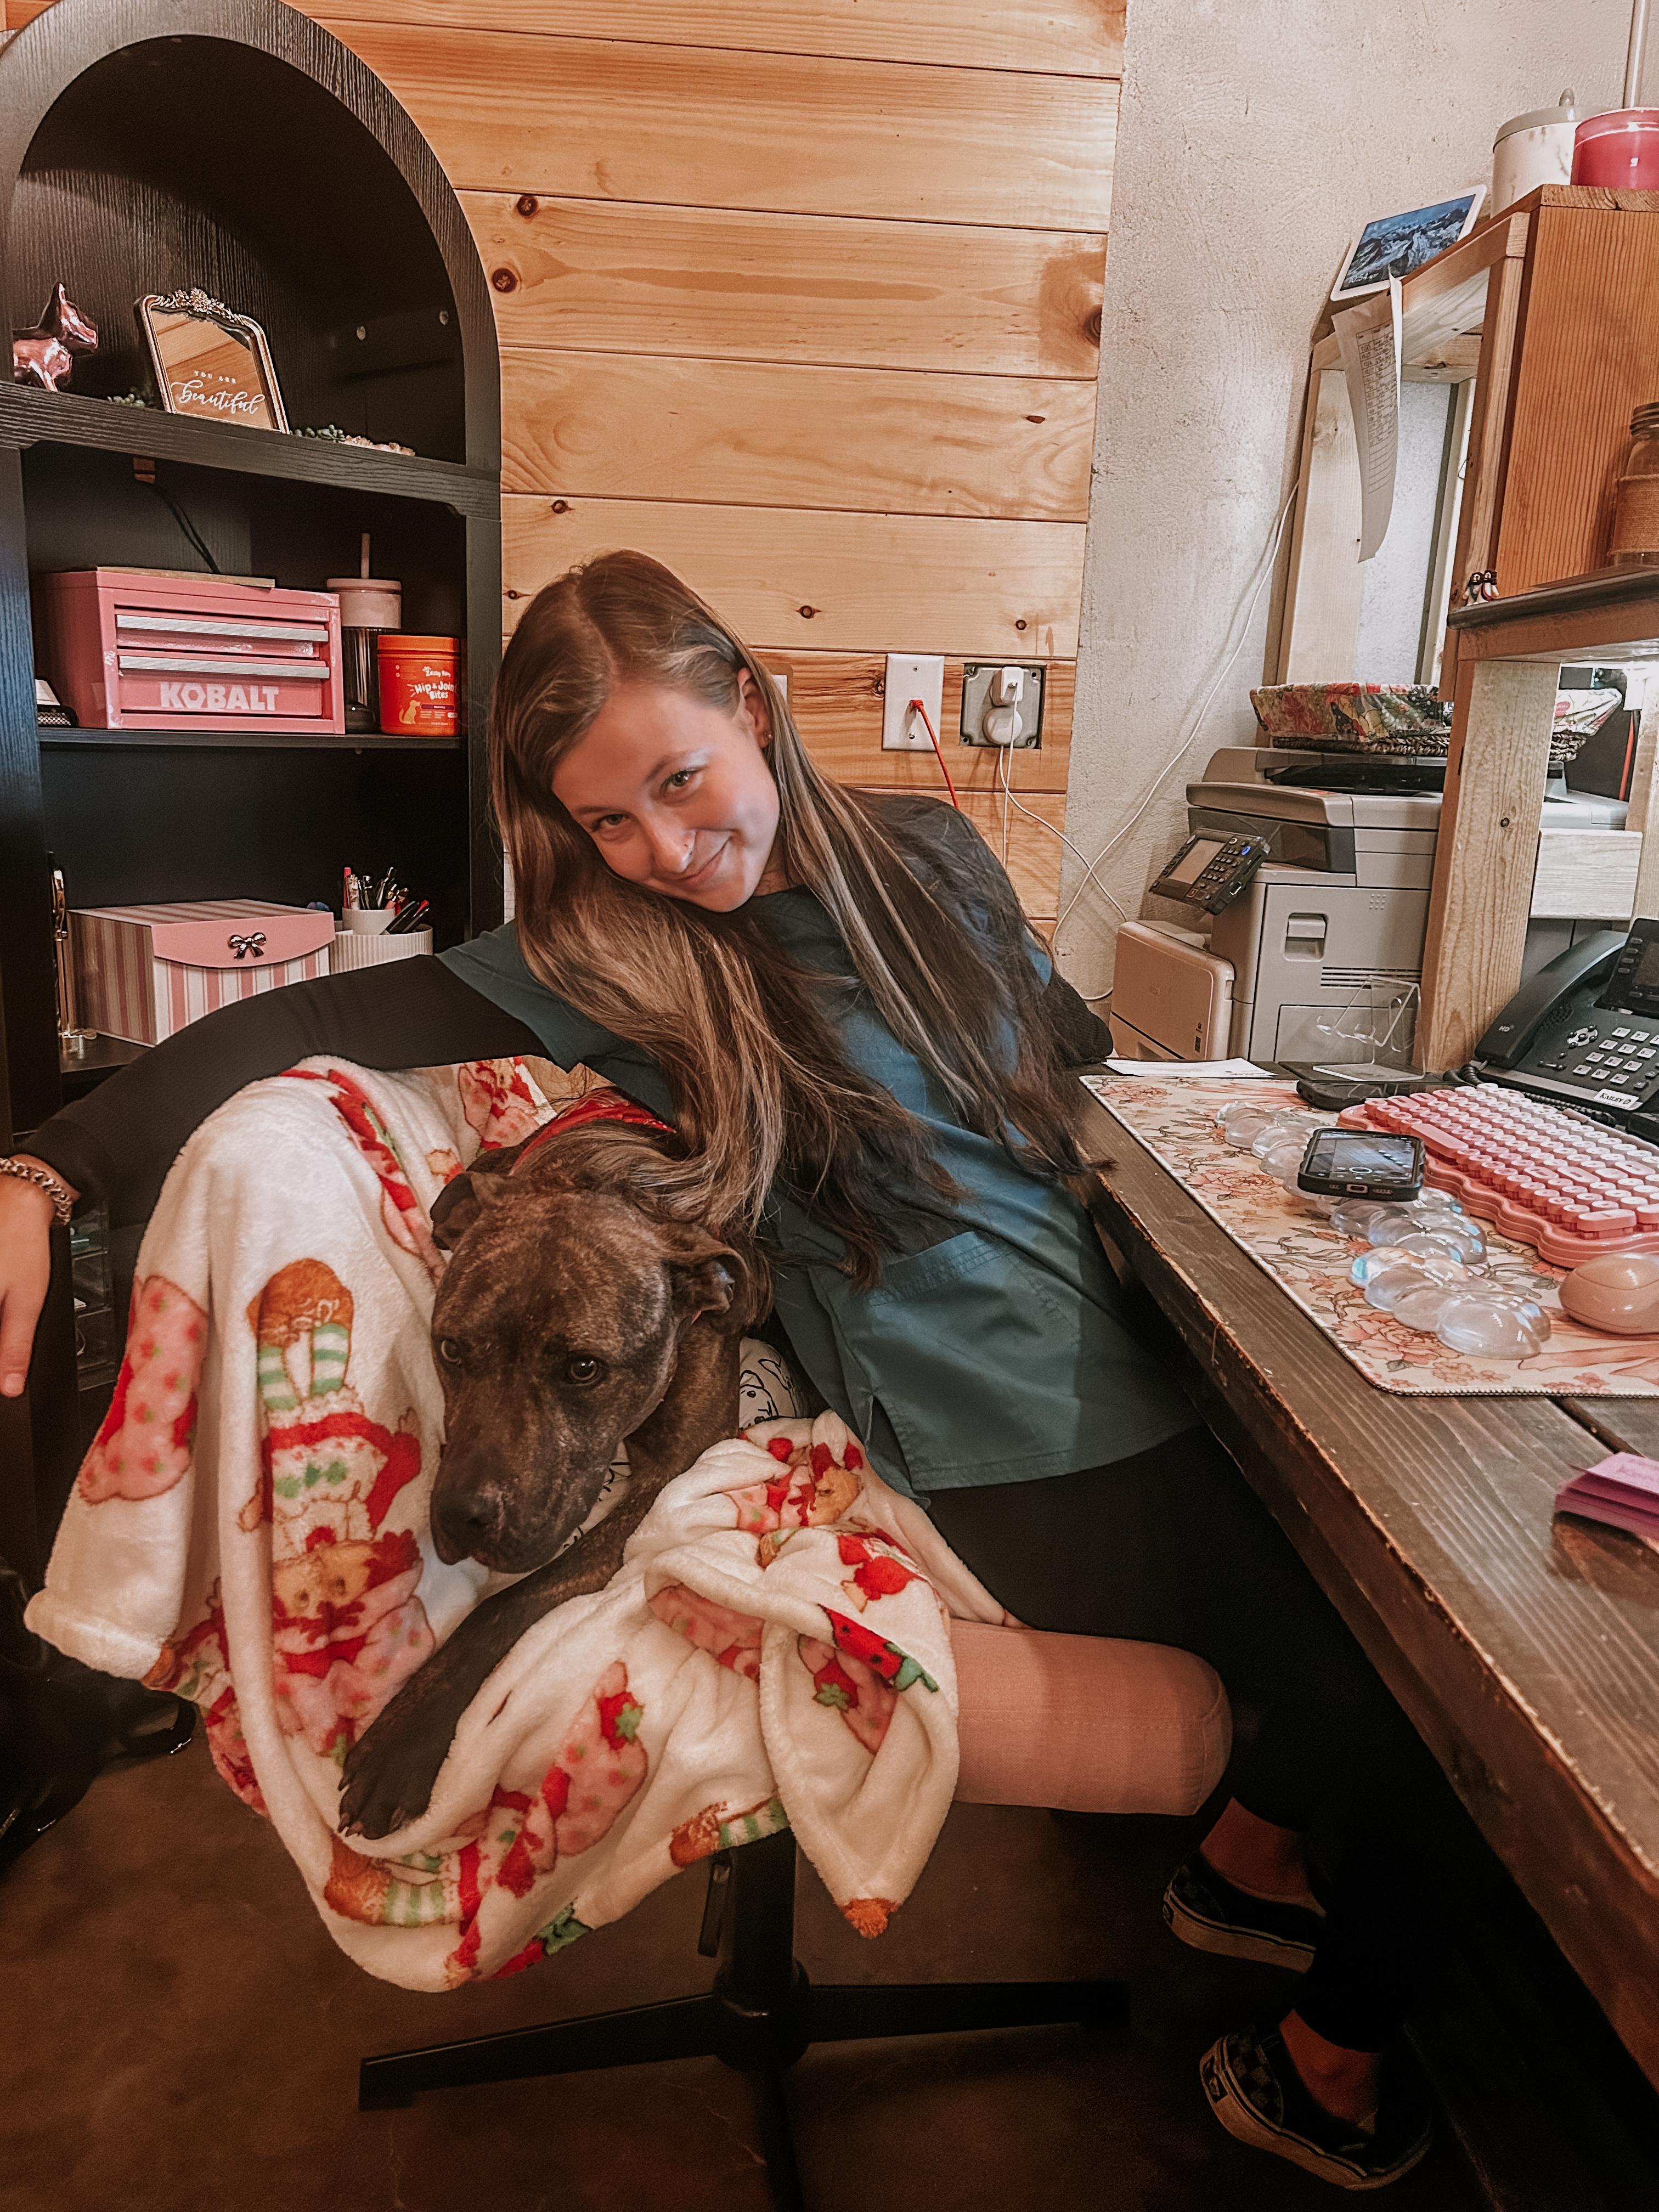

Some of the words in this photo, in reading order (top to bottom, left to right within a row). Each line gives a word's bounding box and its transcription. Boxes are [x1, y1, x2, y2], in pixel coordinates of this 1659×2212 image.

[1348, 273, 1368, 283] 10:54
[193, 370, 212, 379] YOU
[219, 376, 236, 384] ARE
[171, 380, 266, 414] beautiful
[414, 682, 432, 695] Hip
[429, 690, 448, 700] Bites
[160, 681, 279, 711] KOBALT
[1600, 1093, 1623, 1103] KAILEY
